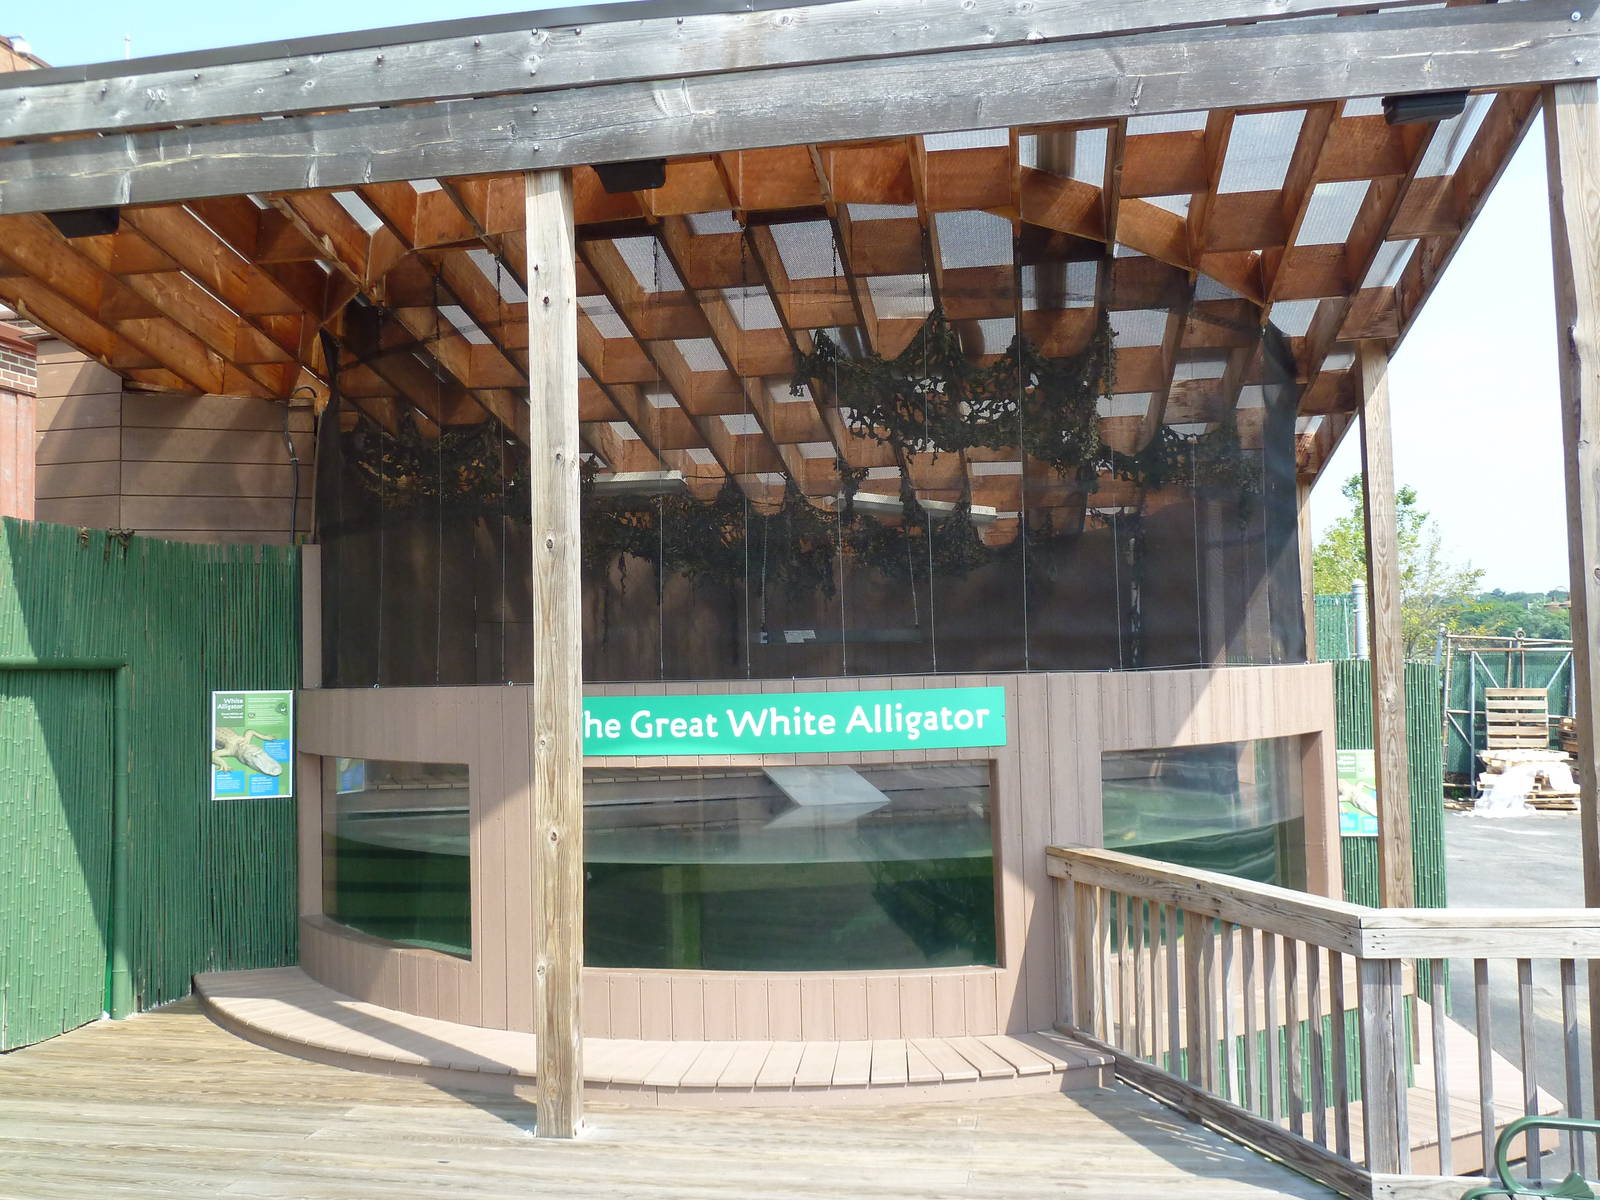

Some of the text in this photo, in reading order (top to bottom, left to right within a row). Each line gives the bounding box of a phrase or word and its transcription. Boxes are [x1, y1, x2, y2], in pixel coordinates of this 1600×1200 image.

[582, 703, 991, 741] he Great White Alligator
